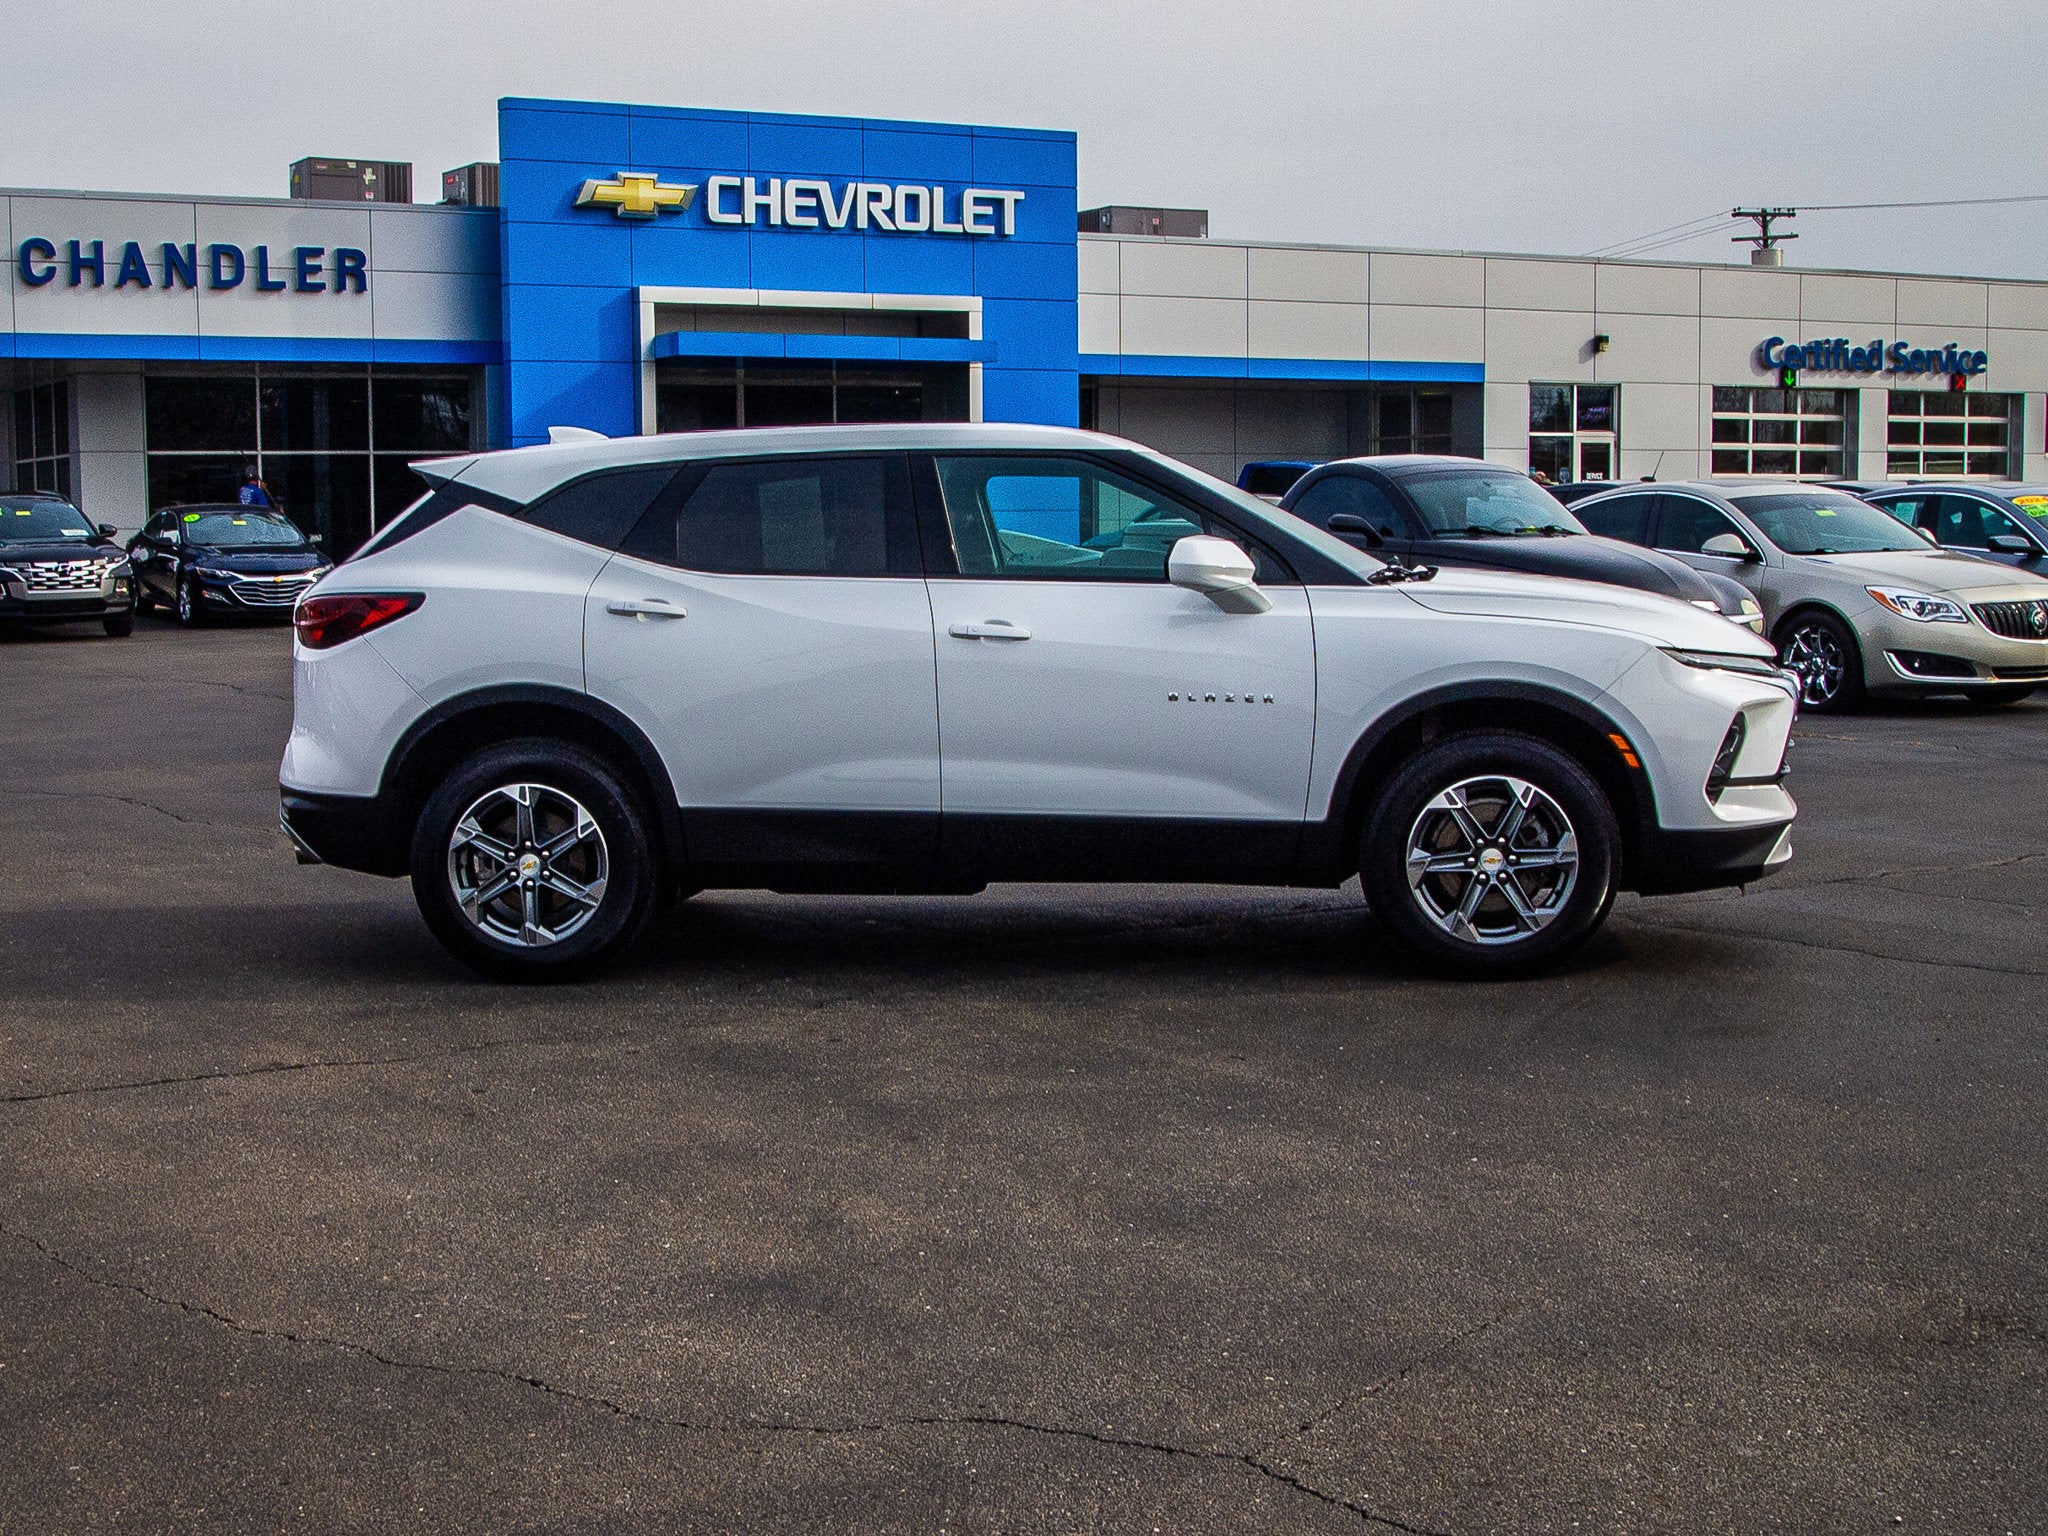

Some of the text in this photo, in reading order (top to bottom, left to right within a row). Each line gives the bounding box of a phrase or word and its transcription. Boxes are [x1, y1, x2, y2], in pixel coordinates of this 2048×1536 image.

[707, 175, 1026, 236] CHEVROLET
[18, 236, 369, 292] CHANDLER
[1762, 336, 1988, 374] Certified Service
[1167, 691, 1275, 704] BLAZER
